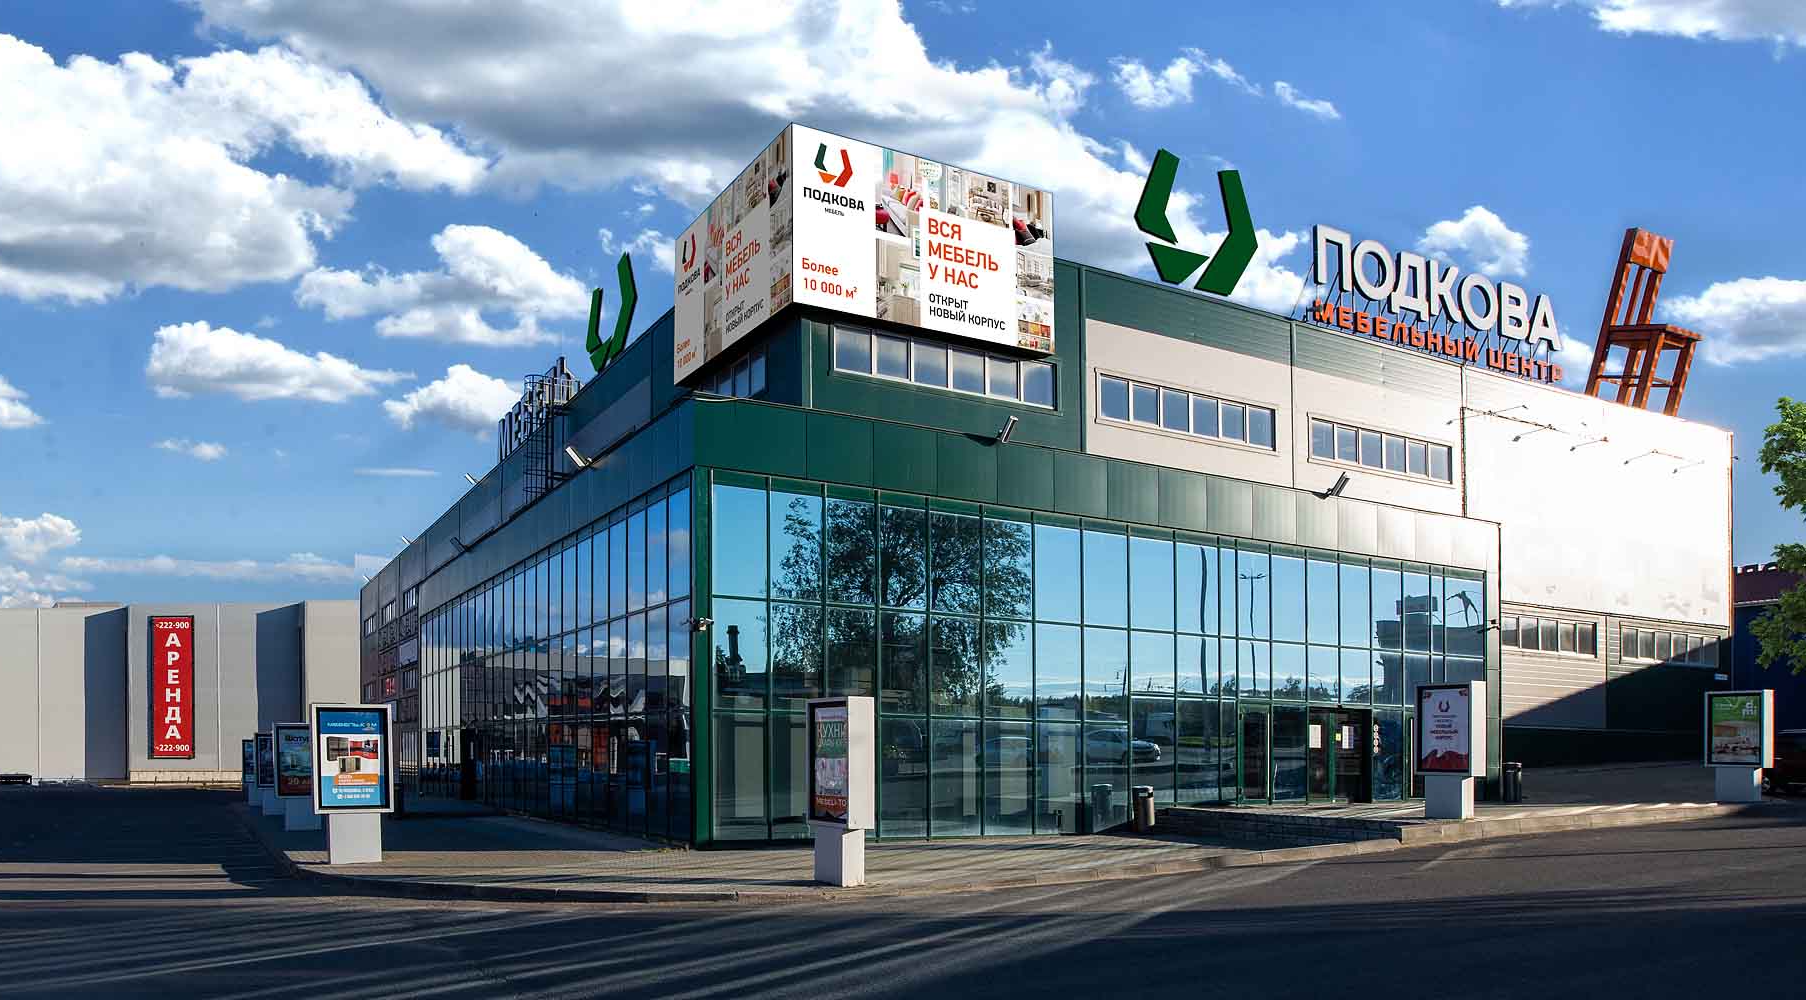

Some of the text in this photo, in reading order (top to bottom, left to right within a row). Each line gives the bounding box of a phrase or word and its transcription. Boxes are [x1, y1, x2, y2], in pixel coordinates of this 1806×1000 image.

[803, 186, 865, 212] ПОДКОВА
[825, 207, 845, 217] МЕБЕЛЬ
[928, 217, 962, 241] ВСЯ
[726, 230, 742, 257] ВСЯ
[928, 240, 1000, 272] МЕБЕЛЬ
[726, 240, 761, 279] МЕБЕЛЬ
[802, 257, 839, 276] Более
[726, 268, 751, 301] У НАС
[804, 277, 817, 291] 10
[821, 281, 843, 296] 000
[928, 262, 979, 289] У НАС
[1312, 224, 1563, 351] ПОДКОВА
[929, 293, 968, 310] ОТКРЫТ
[929, 306, 1006, 331] НОВЫЙ КОРПУС
[1313, 298, 1563, 384] МЕБЕЛЬНЫЙ ЦЕНТР
[164, 632, 182, 740] АРЕНДА
